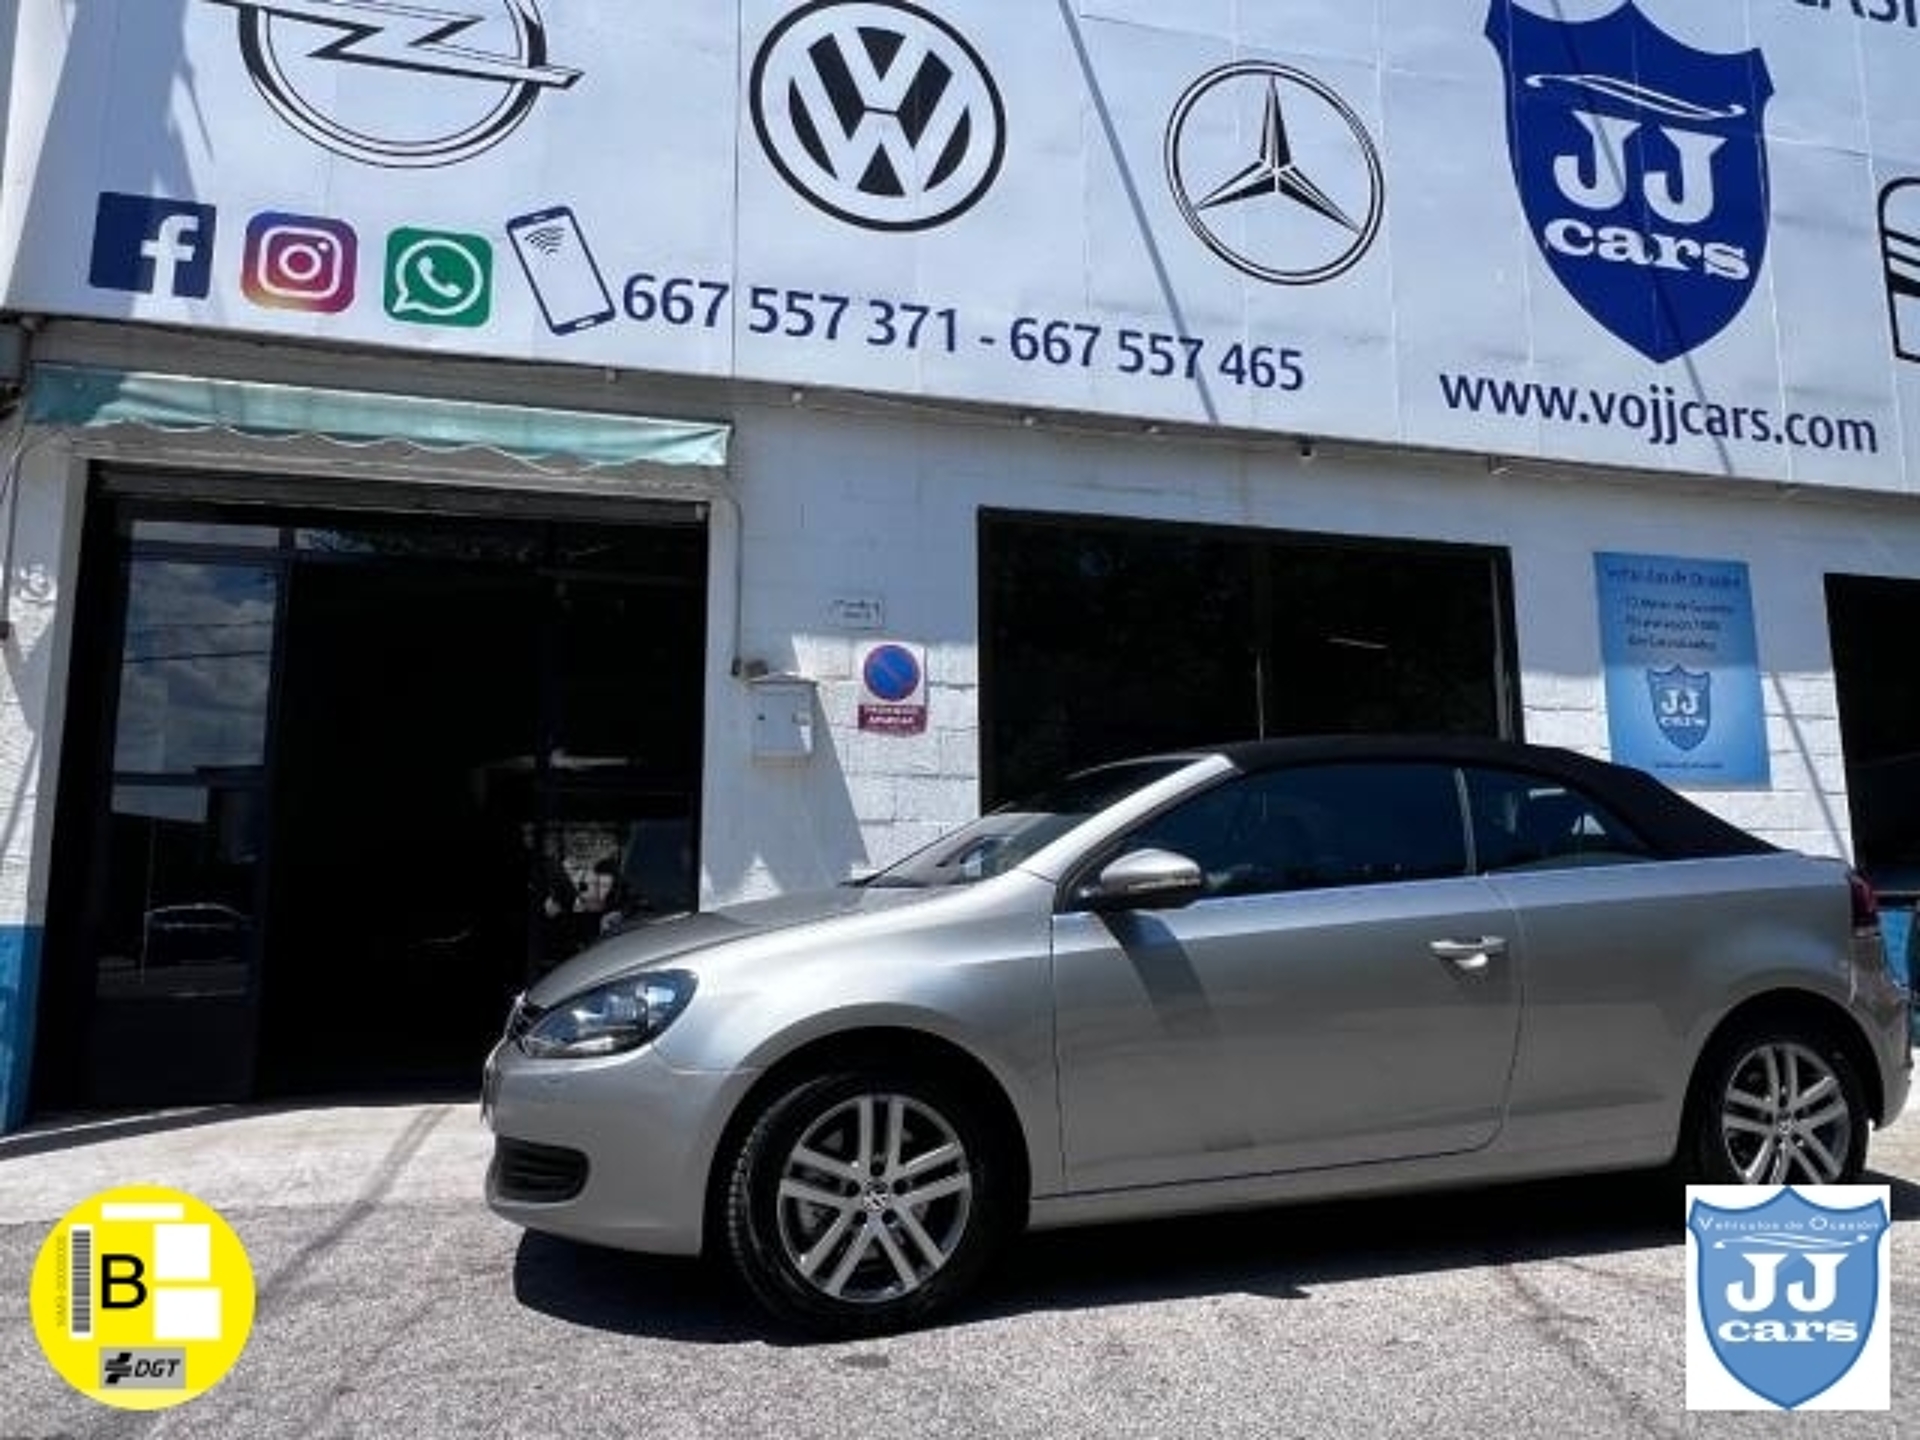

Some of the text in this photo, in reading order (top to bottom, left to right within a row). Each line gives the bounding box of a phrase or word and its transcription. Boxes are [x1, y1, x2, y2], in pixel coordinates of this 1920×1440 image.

[1553, 109, 1729, 225] JJ
[1543, 217, 1751, 281] cars
[622, 272, 731, 328] 667
[748, 286, 850, 342] 557
[866, 298, 958, 353] 371
[1009, 317, 1102, 368] 667
[1116, 328, 1205, 380] 557
[1219, 343, 1305, 392] 465
[1439, 373, 1879, 454] www.vojjcars.com
[1660, 688, 1701, 716] JJ
